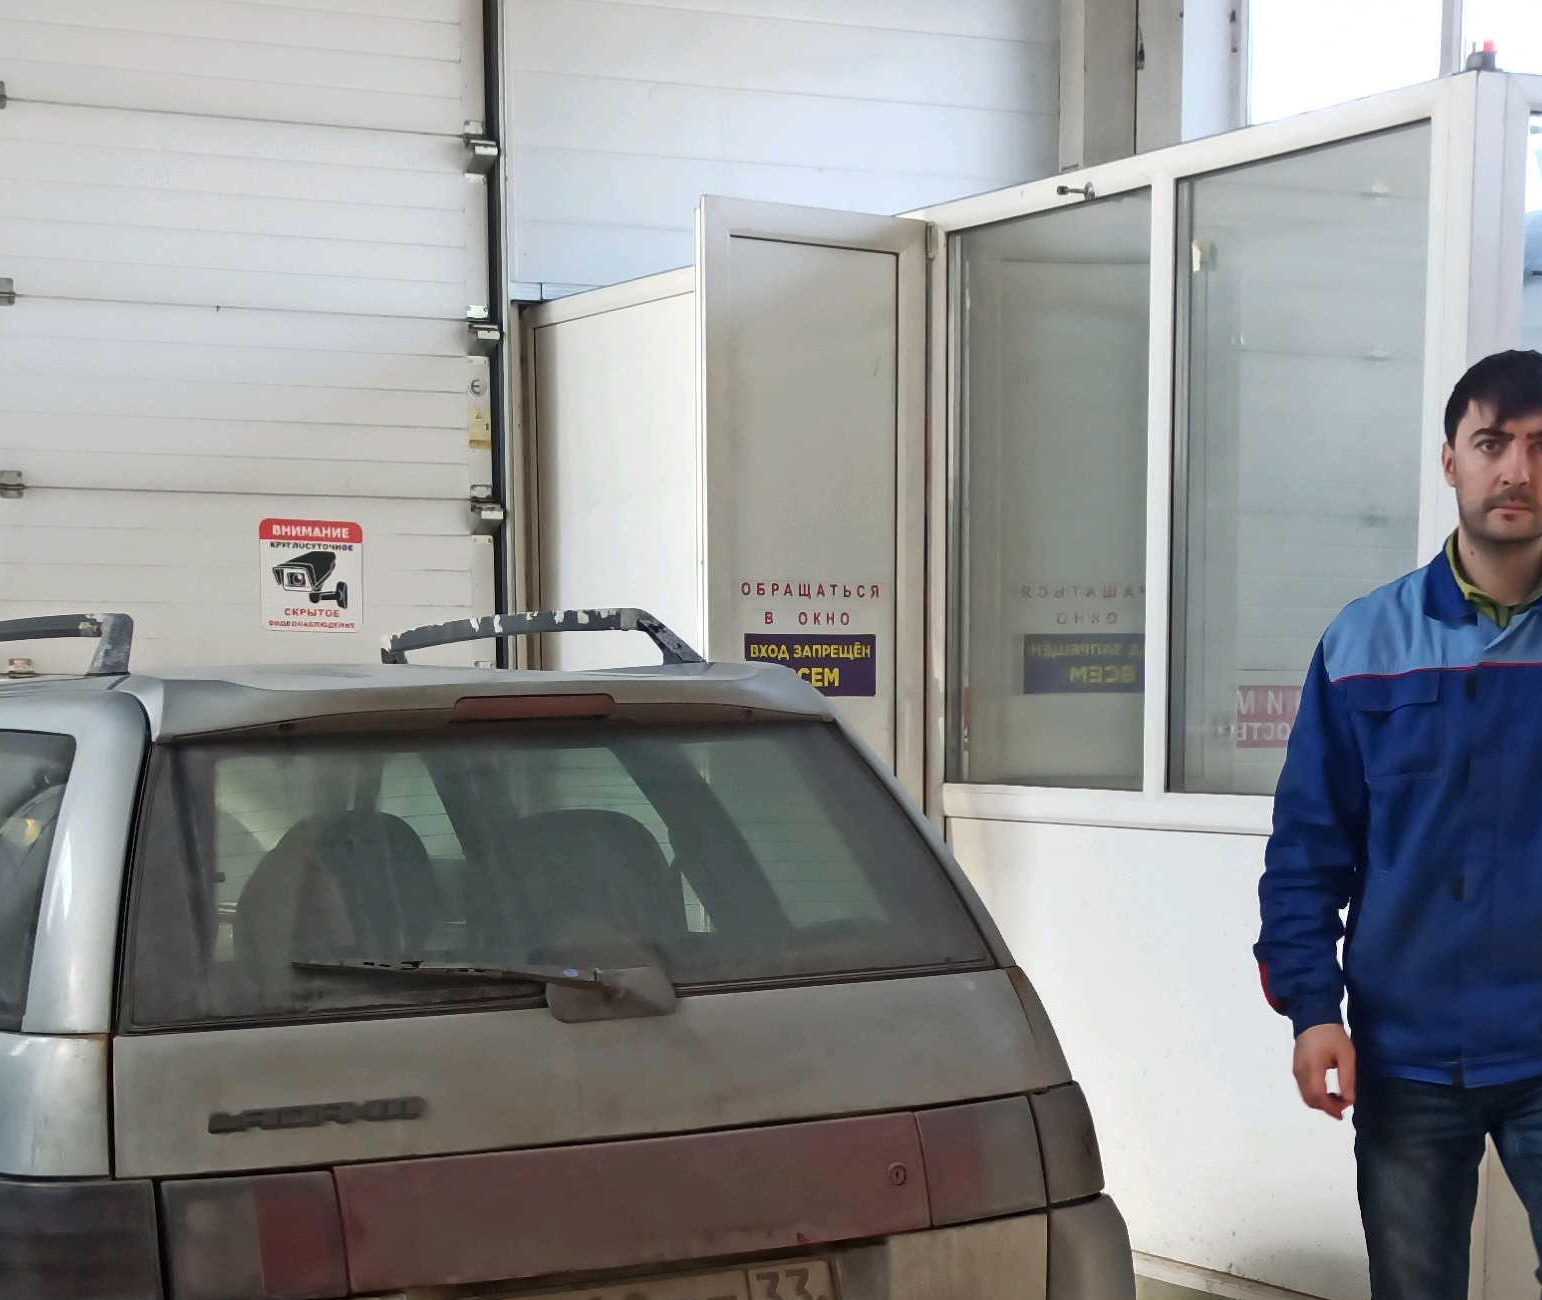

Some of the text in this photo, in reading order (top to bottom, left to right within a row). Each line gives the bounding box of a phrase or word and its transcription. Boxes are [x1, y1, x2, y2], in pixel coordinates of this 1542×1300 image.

[272, 525, 350, 538] ВНИМАНИЕ
[270, 541, 354, 552] КРУГЛОСУТОЧНОЕ
[741, 582, 880, 599] ОБРАЩАТЬСЯ
[284, 607, 340, 617] СКРЫТОЕ
[765, 612, 850, 625] В ОКНО
[750, 642, 871, 660] ВХОД ЗАПРЕЩЁН
[796, 667, 840, 688] СЕМ
